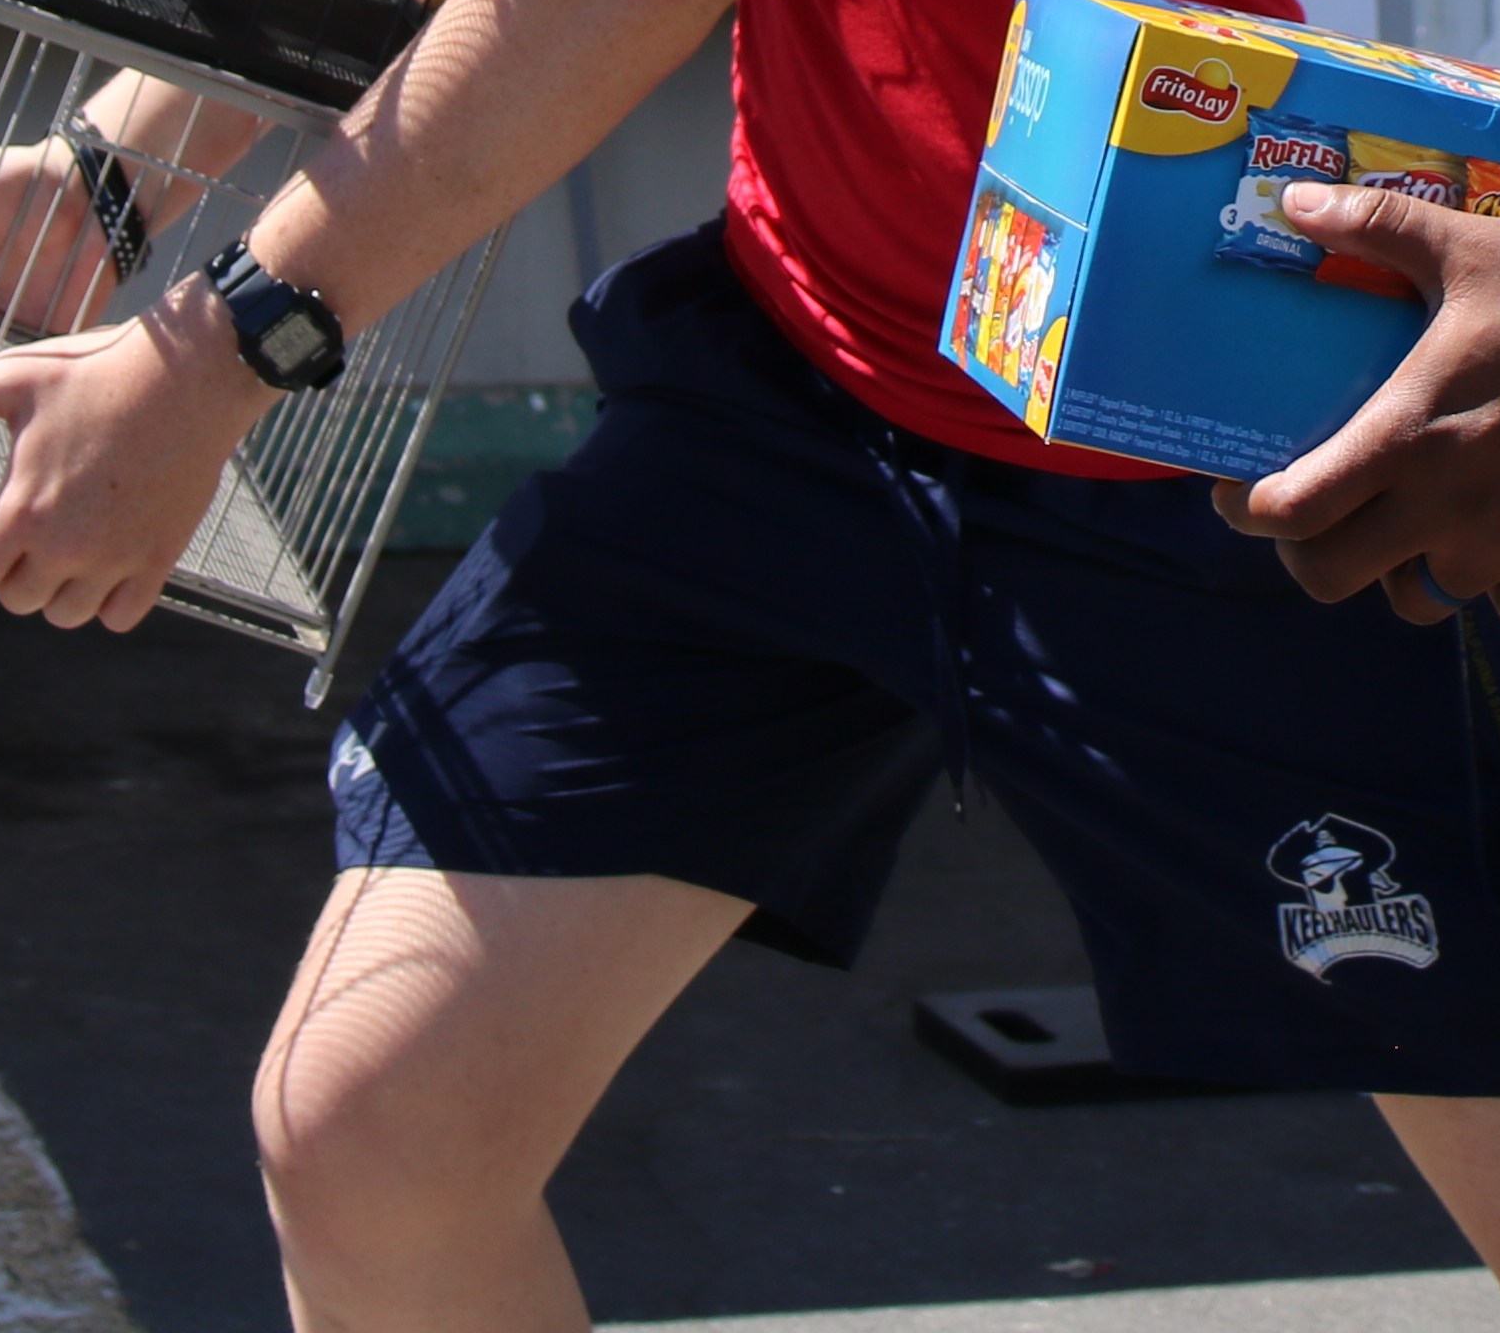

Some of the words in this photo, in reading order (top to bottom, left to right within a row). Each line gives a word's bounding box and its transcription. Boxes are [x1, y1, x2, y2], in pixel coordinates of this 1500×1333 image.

[1250, 135, 1347, 179] RUFFLES
[1226, 208, 1238, 226] 3
[1256, 232, 1303, 258] ORIGINAL
[1282, 897, 1431, 957] KEELHAULERS
